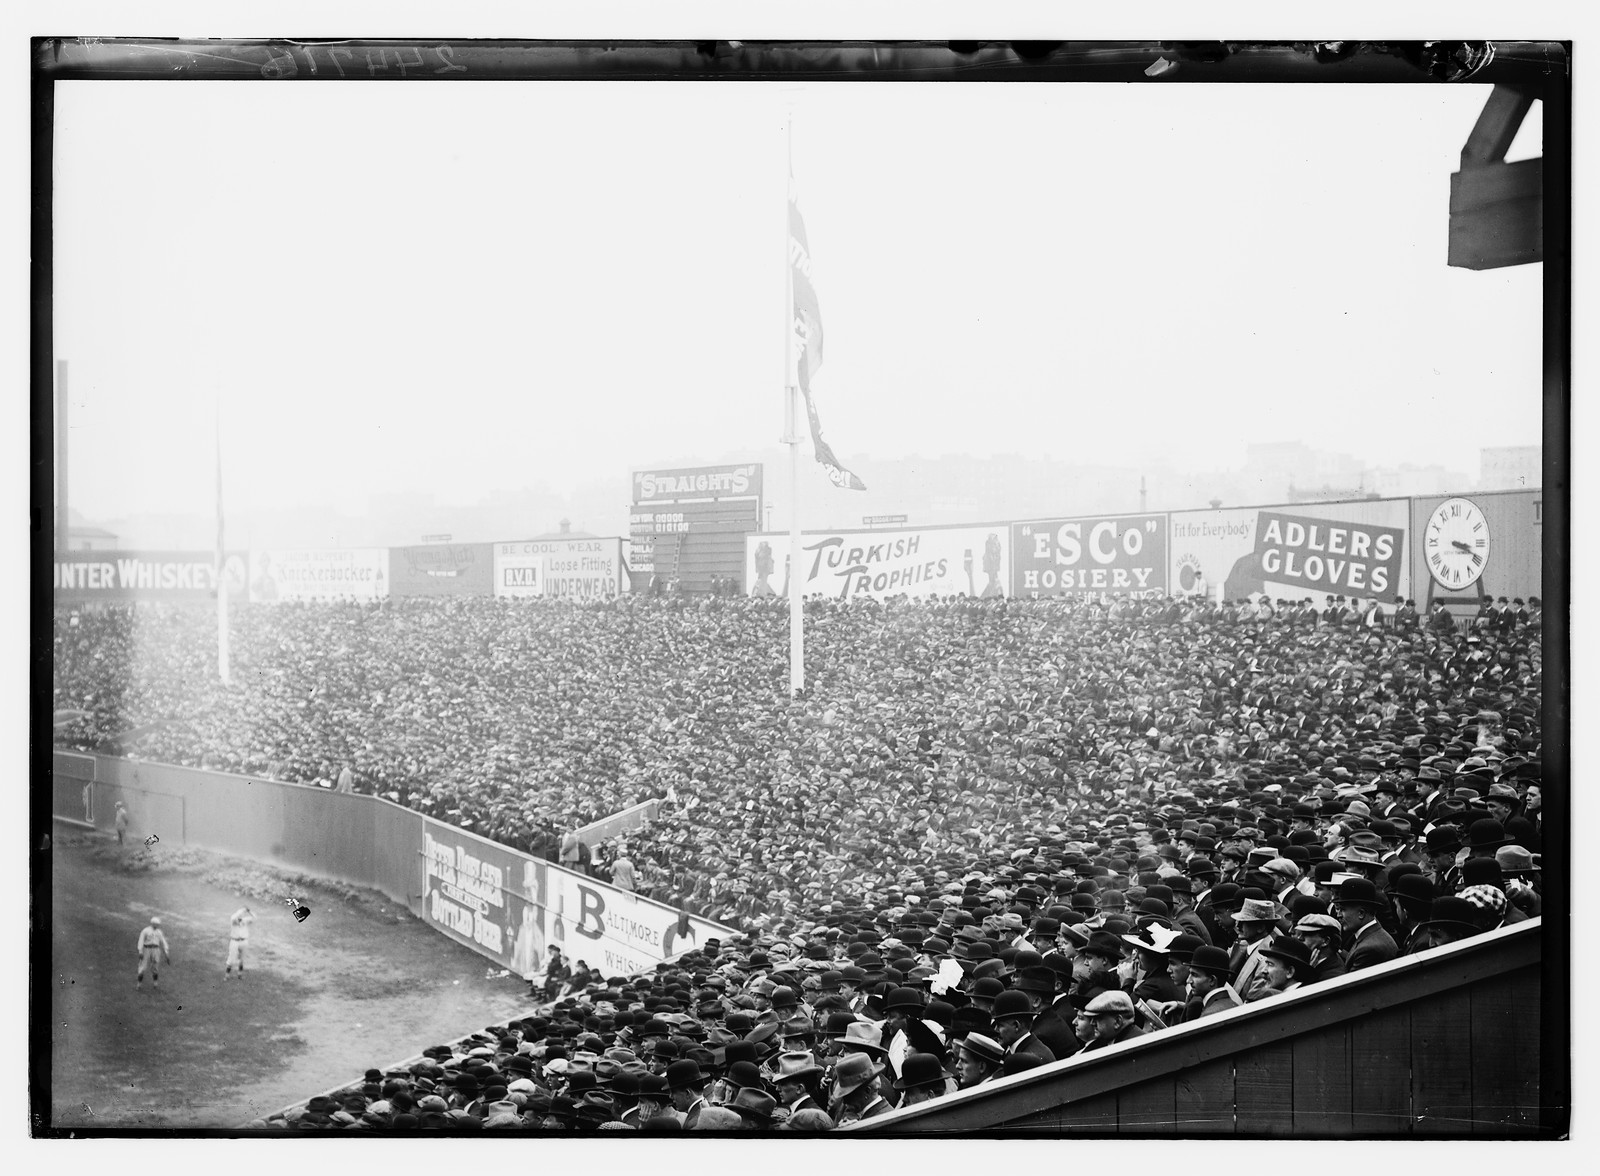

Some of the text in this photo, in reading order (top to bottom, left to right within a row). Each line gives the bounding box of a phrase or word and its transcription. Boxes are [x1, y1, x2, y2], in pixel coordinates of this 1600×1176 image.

[1451, 504, 1461, 517] XII
[1187, 523, 1201, 537] for
[1263, 519, 1394, 561] ADLERS
[502, 545, 516, 555] BE
[568, 542, 603, 552] WEAR
[1476, 539, 1485, 548] III
[550, 556, 612, 576] Loose Fitting
[802, 535, 921, 582] TURKISH
[117, 559, 218, 589] WHISKEY
[276, 562, 373, 583] Knickerbocker
[834, 558, 948, 599] TROPHIES
[1024, 568, 1153, 588] HOSIERY
[1261, 549, 1389, 593] GLOVES
[546, 577, 616, 597] UNDERWEAR
[575, 884, 659, 947] BALTIMORE
